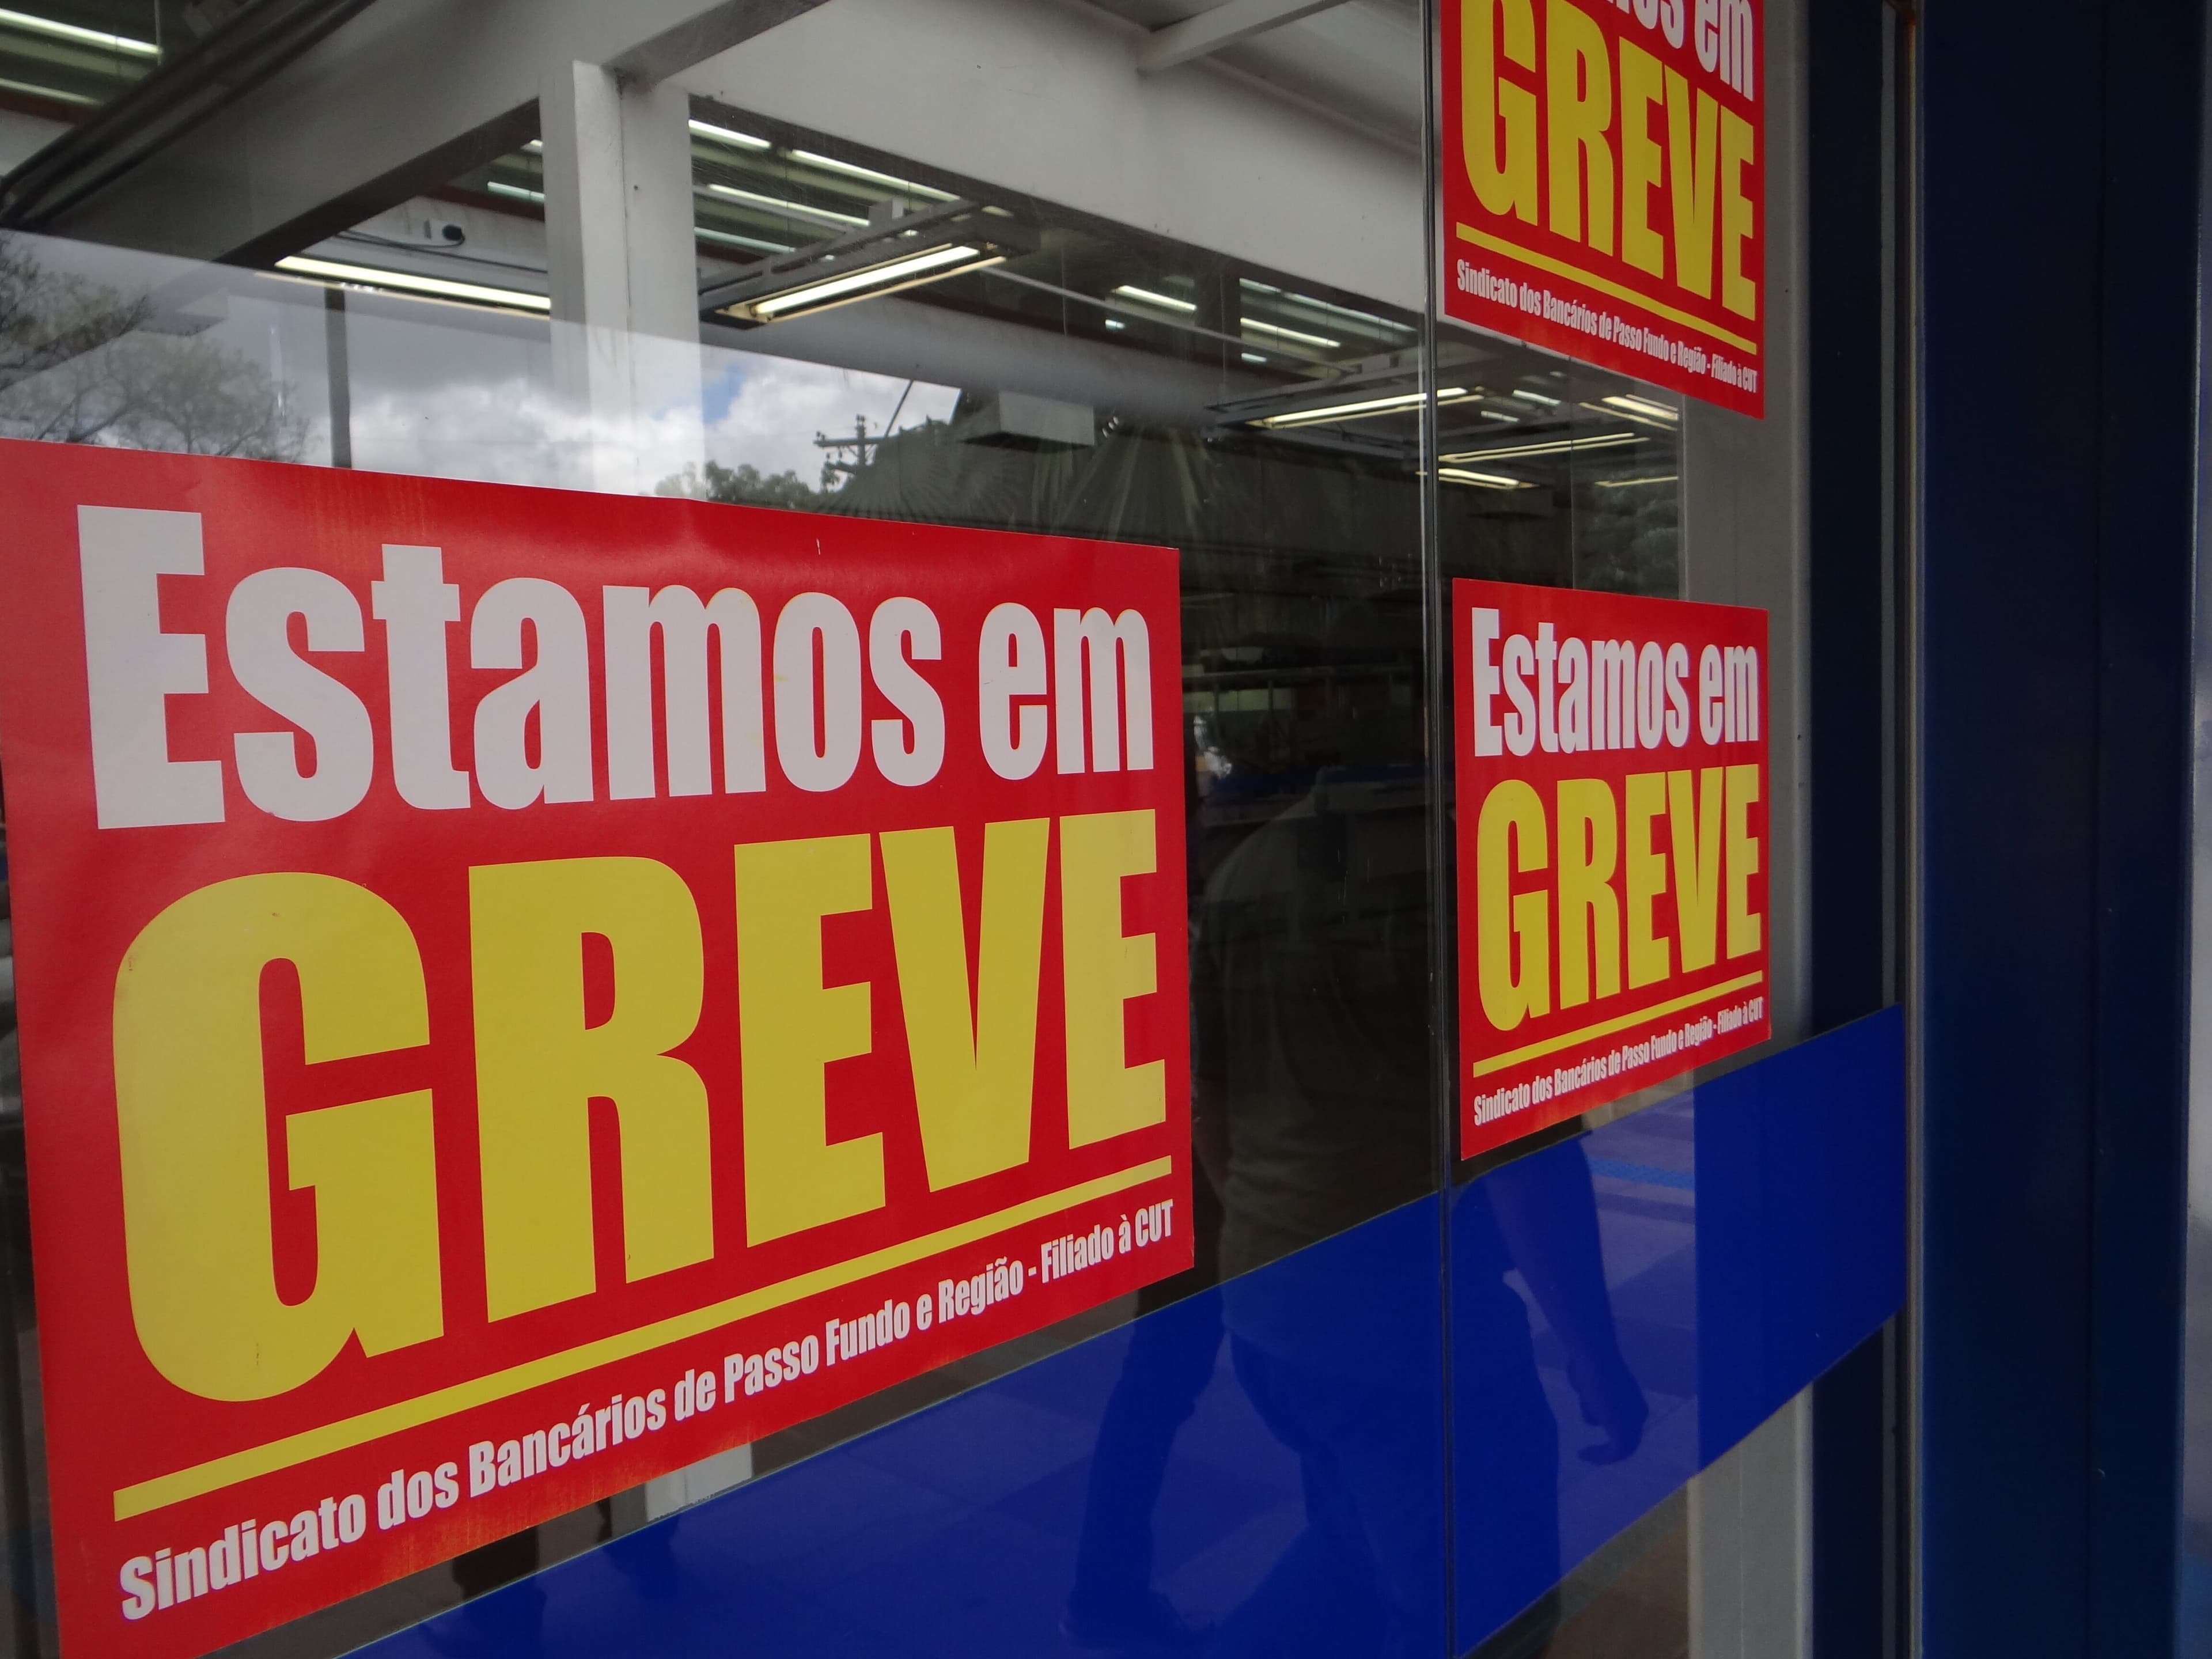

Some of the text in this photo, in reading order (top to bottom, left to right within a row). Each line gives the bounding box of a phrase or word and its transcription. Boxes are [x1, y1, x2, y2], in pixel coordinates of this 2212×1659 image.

[1461, 0, 1755, 320] GREVE
[1457, 258, 1518, 309] Sindicato
[1519, 282, 1541, 316] dos
[1543, 289, 1598, 336] Bancários
[1598, 311, 1612, 341] de
[1612, 315, 1643, 351] Passo
[1643, 327, 1669, 362] Fundo
[1670, 342, 1677, 364] e
[1677, 340, 1707, 375] Região
[1711, 353, 1737, 385] Filiado
[1737, 363, 1743, 388] à
[1742, 366, 1758, 393] CUT
[77, 505, 1154, 830] Estamos em
[1472, 608, 1759, 757] Estamos em
[1477, 764, 1761, 1031] GREVE
[113, 809, 1167, 1402] GREVE
[1474, 1082, 1531, 1126] Sindicato
[1531, 1075, 1553, 1105] dos
[1554, 1057, 1608, 1097] Bancários
[1608, 1049, 1622, 1077] de
[1621, 1042, 1650, 1071] Passo
[1650, 1029, 1677, 1061] Fundo
[1677, 1029, 1684, 1050] e
[1684, 1015, 1713, 1048] Região
[1717, 1005, 1743, 1035] Filiado
[1742, 1001, 1748, 1025] à
[1748, 996, 1763, 1022] CUT
[120, 1199, 1173, 1620] Sindicato dos Bancários de Passo Fundo e Região - Filiado à CUT
